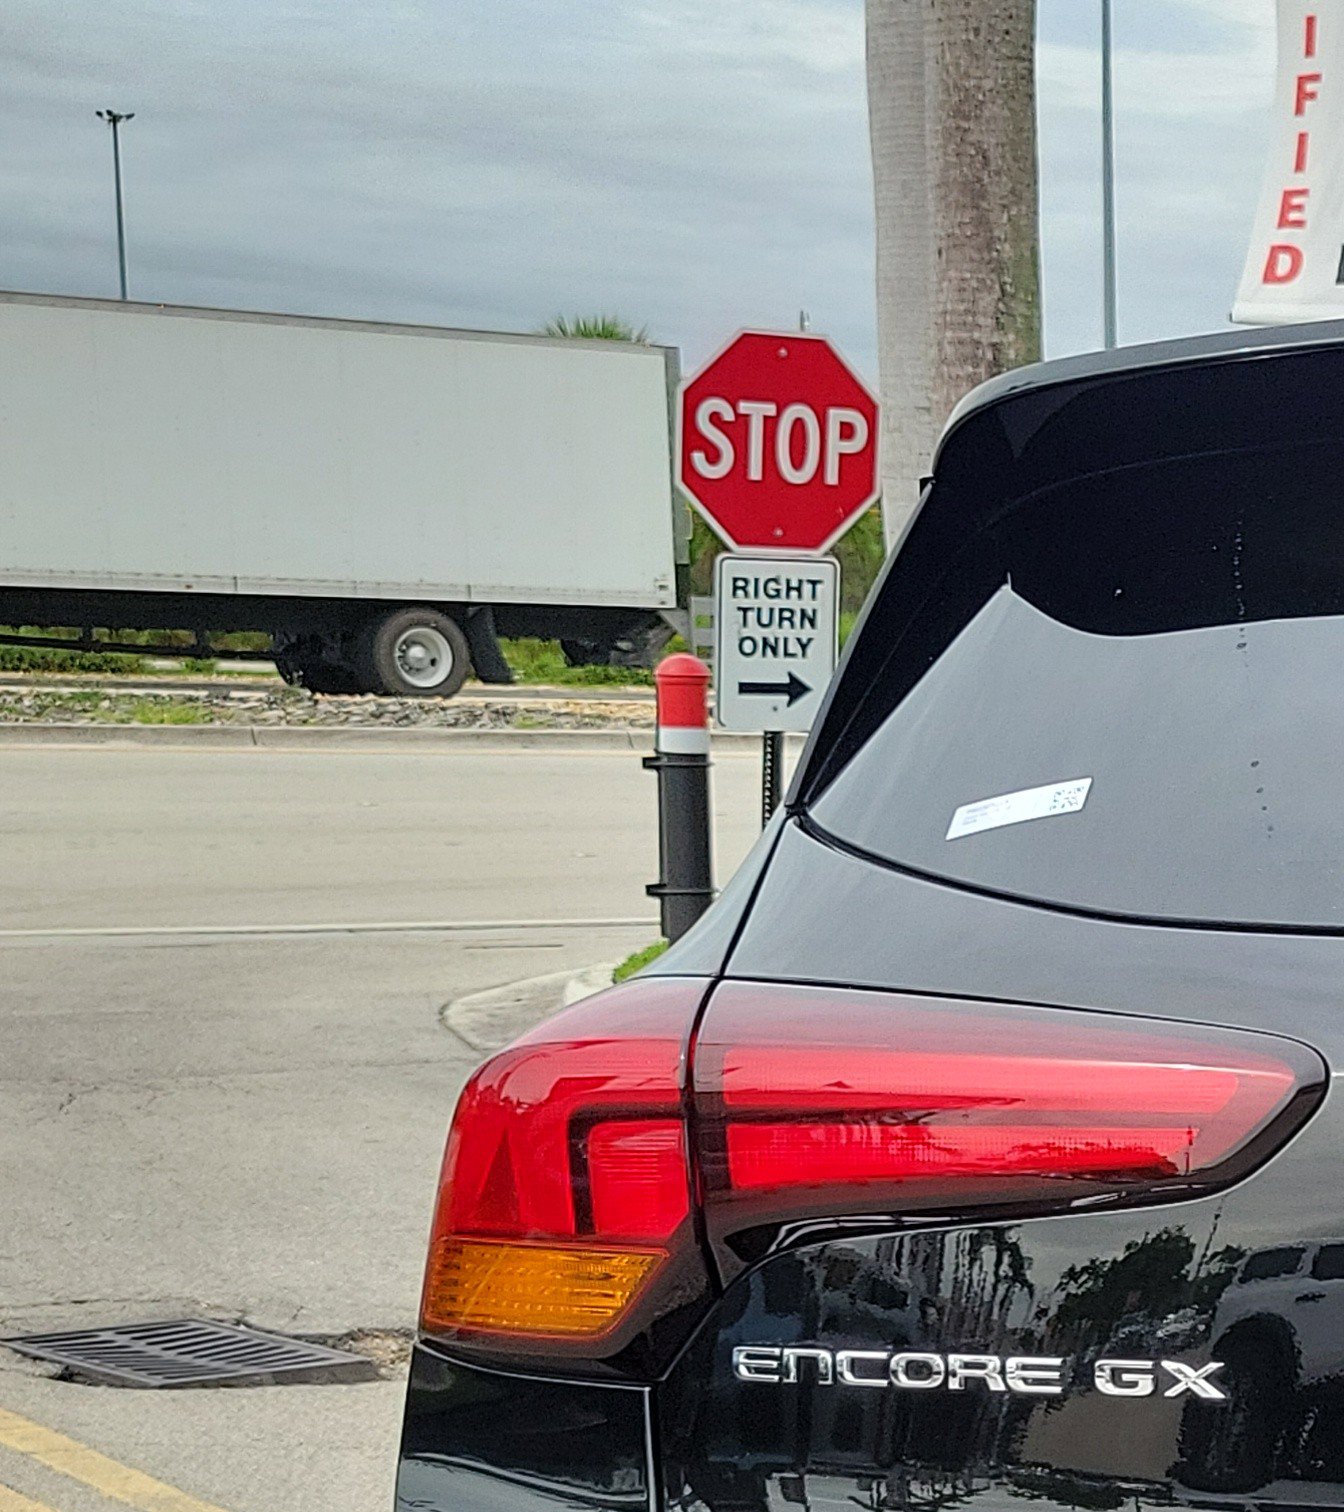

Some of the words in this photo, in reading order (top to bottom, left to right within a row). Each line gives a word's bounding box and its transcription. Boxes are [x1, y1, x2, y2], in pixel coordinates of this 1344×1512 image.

[690, 397, 869, 487] STOP
[731, 576, 825, 601] RIGHT
[738, 606, 817, 630] TURN
[738, 635, 814, 659] ONLY
[732, 1346, 1065, 1395] ENCORE
[1093, 1358, 1226, 1400] GX
